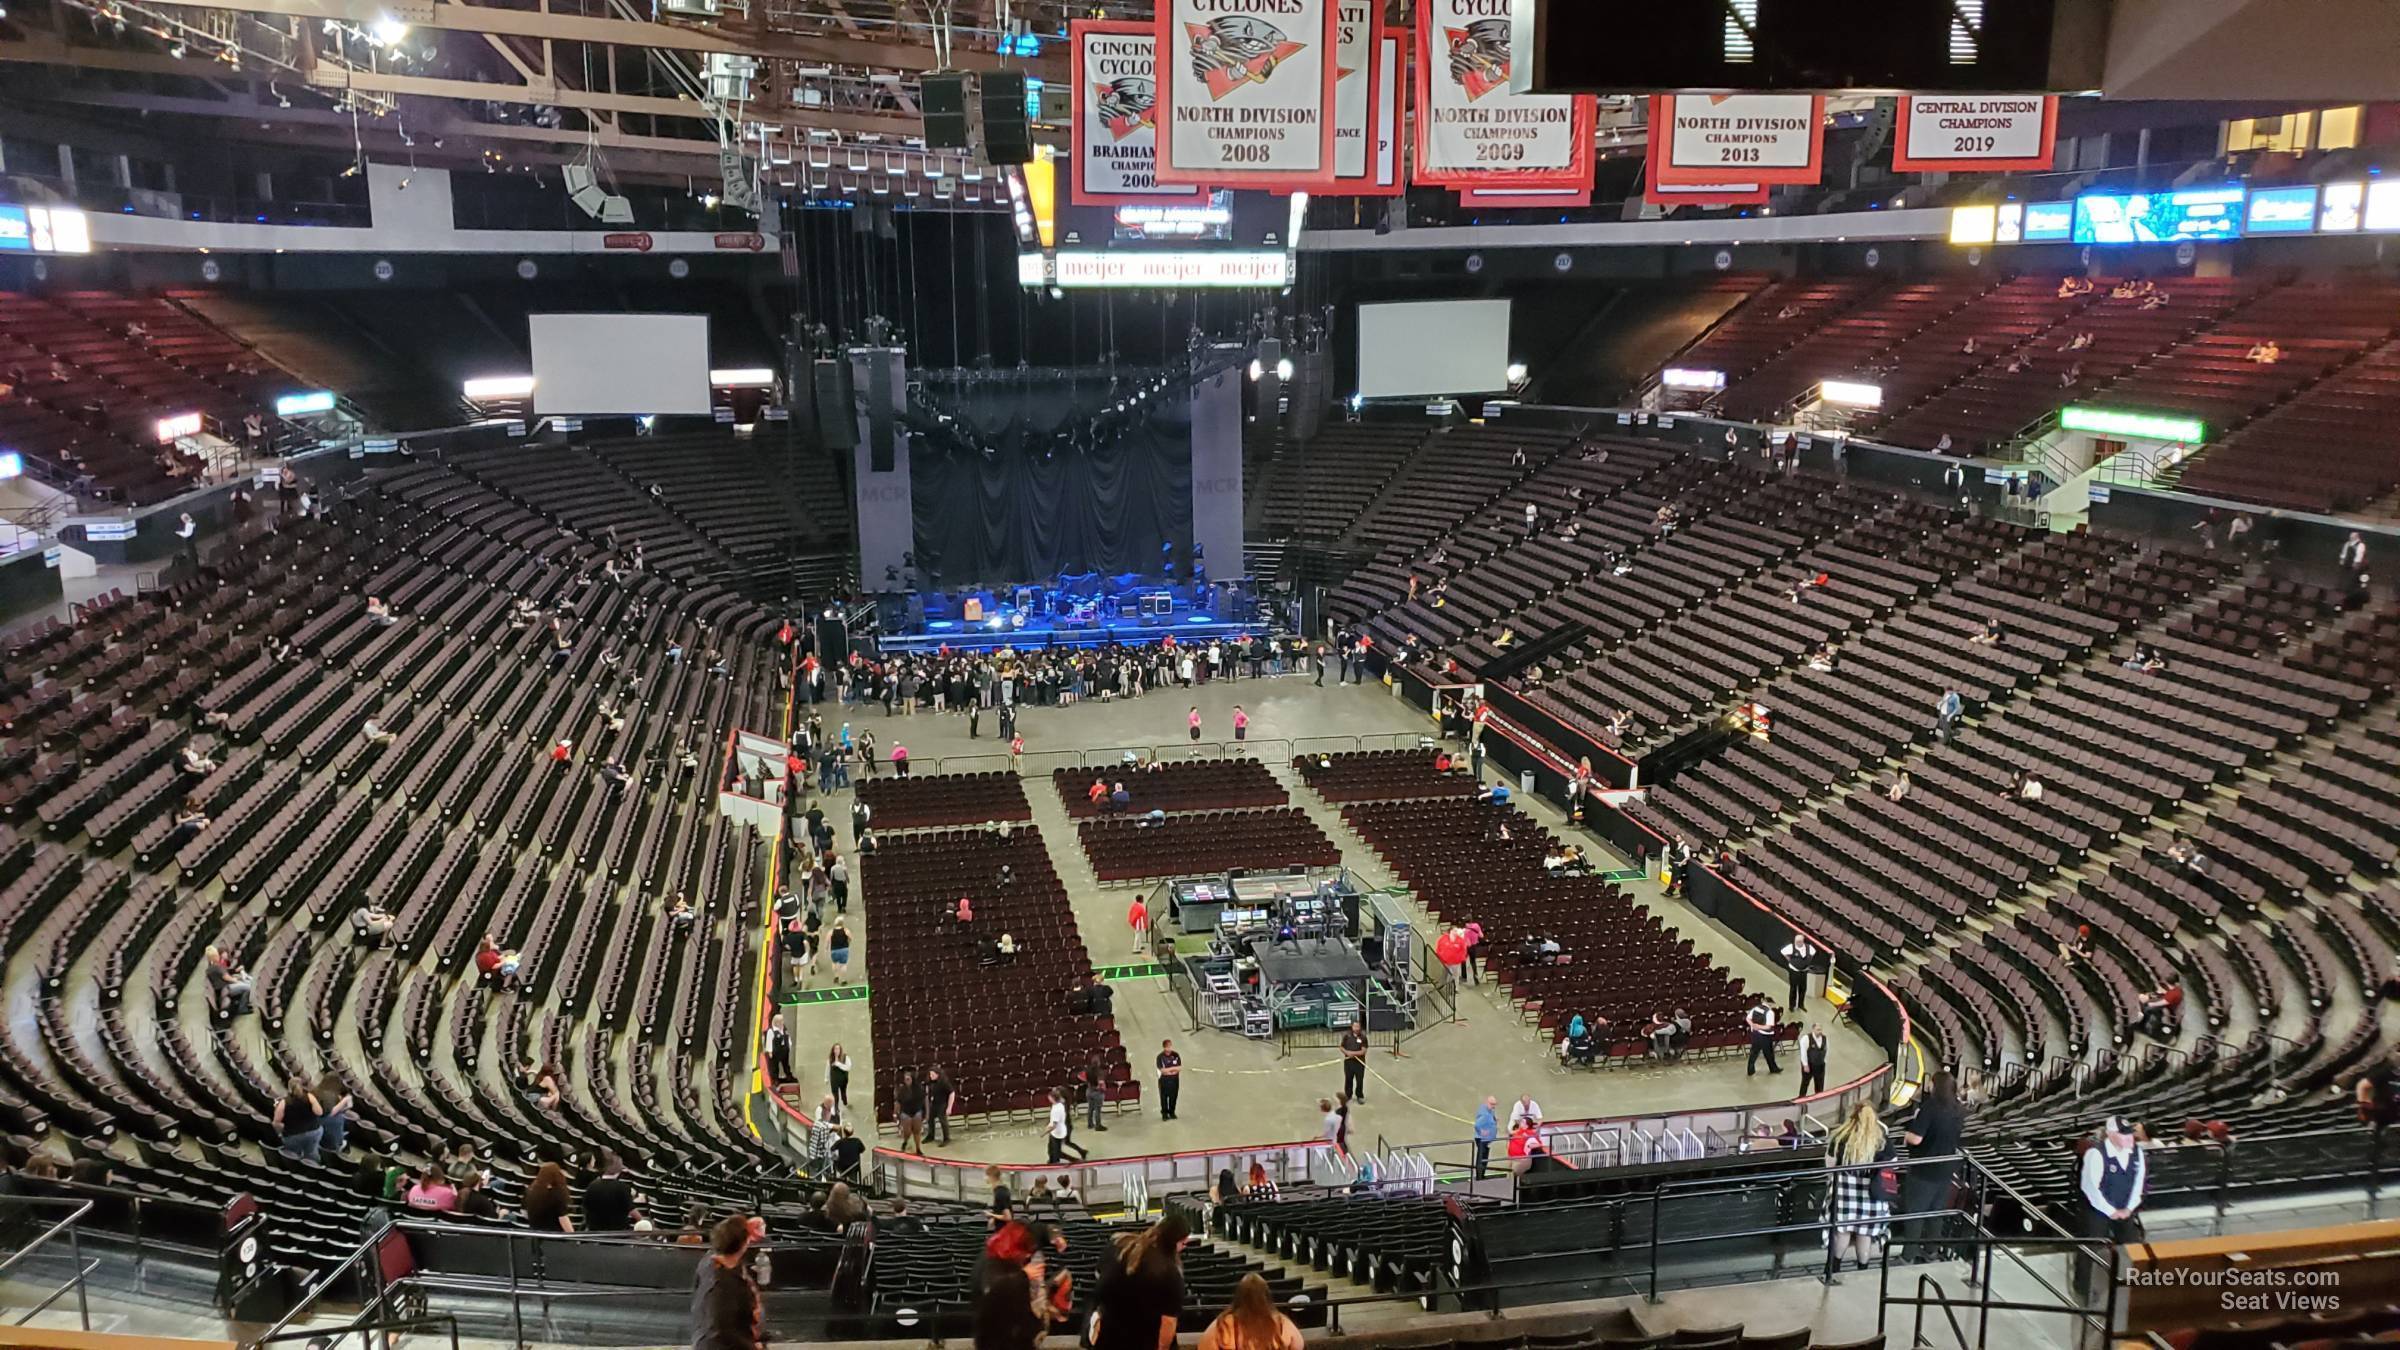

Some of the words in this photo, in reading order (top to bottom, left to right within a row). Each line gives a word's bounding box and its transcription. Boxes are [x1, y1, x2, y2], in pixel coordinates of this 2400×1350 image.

[1090, 41, 1156, 56] CINCIN
[1100, 59, 1156, 75] CYCLO
[1916, 102, 1976, 113] CENTRAL
[1979, 101, 2037, 113] DIVISION
[1177, 106, 1234, 122] NORTH
[1240, 108, 1317, 124] DIVISION
[1434, 108, 1489, 123] NORTH
[1494, 108, 1568, 123] DIVISION
[1677, 117, 1731, 130] NORTH
[1736, 118, 1807, 130] DIVISION
[1939, 118, 2013, 129] CHAMPIONS
[1207, 127, 1285, 140] CHAMPIONS
[1464, 127, 1538, 139] CHAMPIONS
[1705, 133, 1778, 143] CHAMPIONS
[1954, 136, 1995, 152] 2019
[1221, 143, 1270, 162] 2008
[1476, 143, 1524, 161] 2009
[1721, 148, 1760, 162] 2013
[1066, 256, 1125, 279] meijer
[1144, 256, 1202, 279] meijer
[1220, 256, 1278, 280] meijer
[1196, 478, 1240, 493] MCR
[860, 486, 908, 501] MCR
